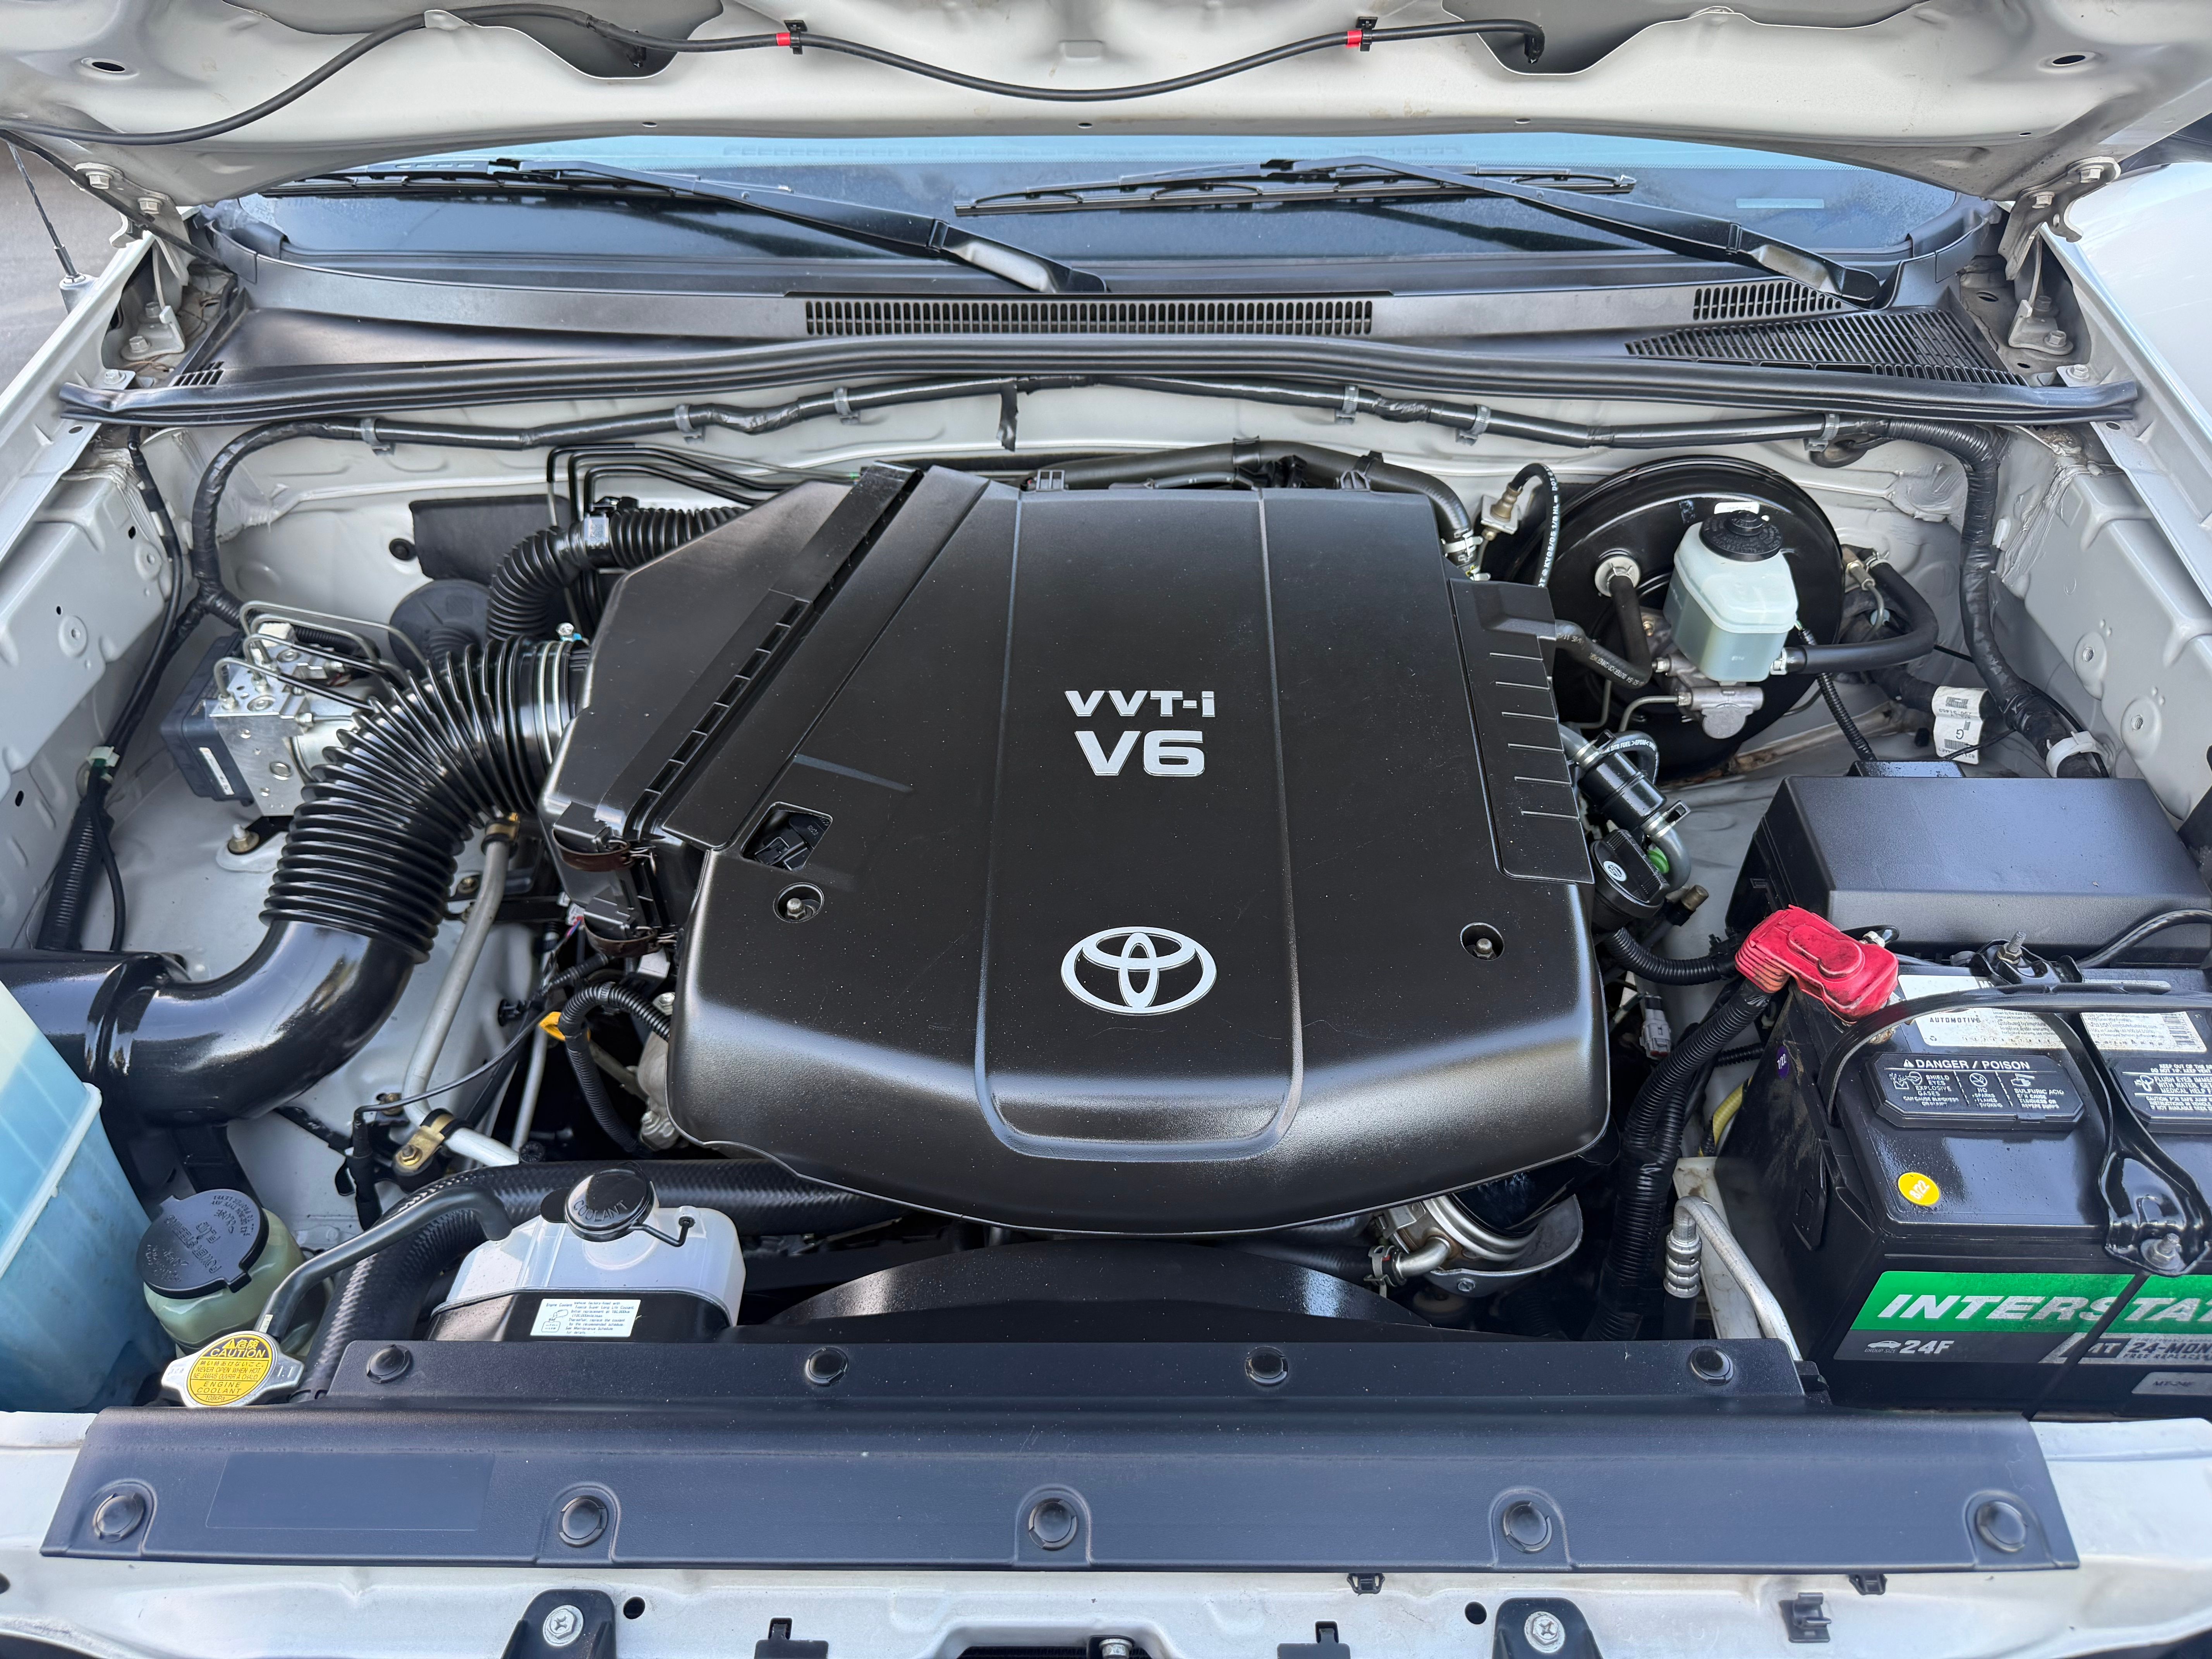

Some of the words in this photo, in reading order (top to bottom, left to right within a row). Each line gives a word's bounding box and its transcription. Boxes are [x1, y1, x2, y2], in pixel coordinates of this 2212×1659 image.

[1065, 690, 1215, 717] VVT-i
[1956, 728, 1964, 740] G
[1074, 730, 1205, 777] V6
[1915, 1060, 1969, 1069] DANGER
[1982, 1061, 2030, 1069] POISON
[574, 1200, 628, 1222] COOLANT
[165, 1214, 200, 1249] STEERING
[196, 1221, 221, 1244] FLUID
[192, 1242, 222, 1274] POWER
[210, 1348, 266, 1358] CAUTION
[235, 1339, 259, 1349] 危険
[1899, 1340, 1954, 1354] 24F
